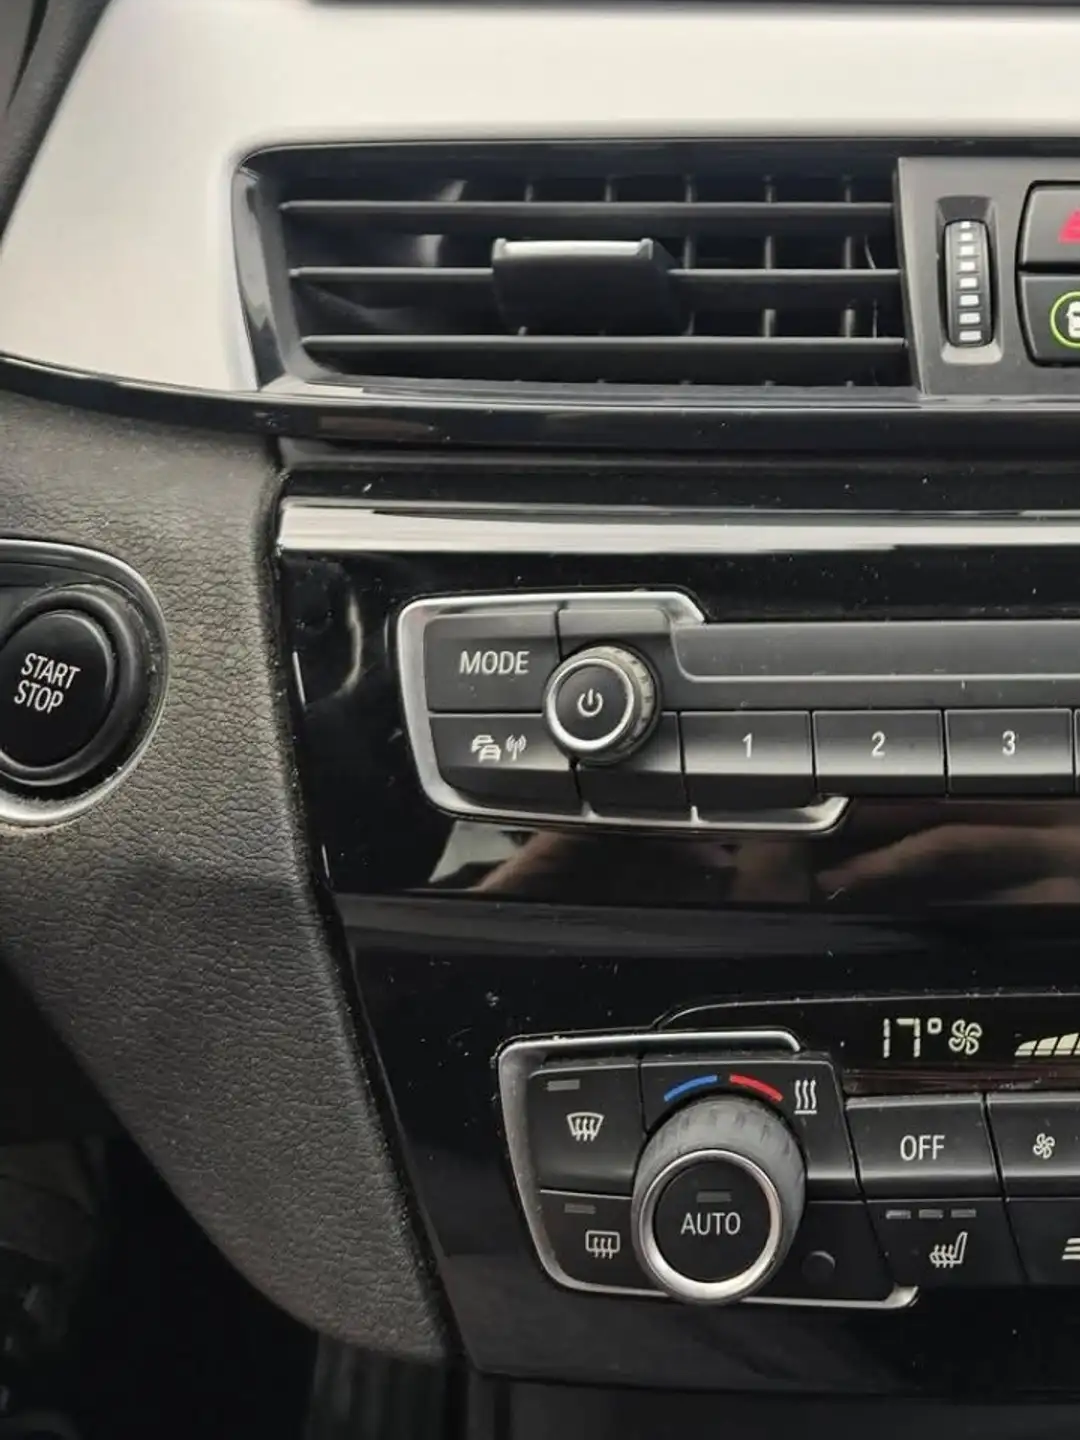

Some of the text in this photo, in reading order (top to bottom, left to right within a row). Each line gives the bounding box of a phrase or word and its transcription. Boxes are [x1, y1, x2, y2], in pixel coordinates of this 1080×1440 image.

[21, 652, 81, 690] START
[459, 650, 530, 676] MODE
[14, 680, 64, 714] STOP
[743, 733, 753, 758] 1
[871, 732, 885, 757] 2
[1001, 730, 1016, 756] 3
[900, 1134, 945, 1161] OFF
[680, 1212, 741, 1236] AUTO
